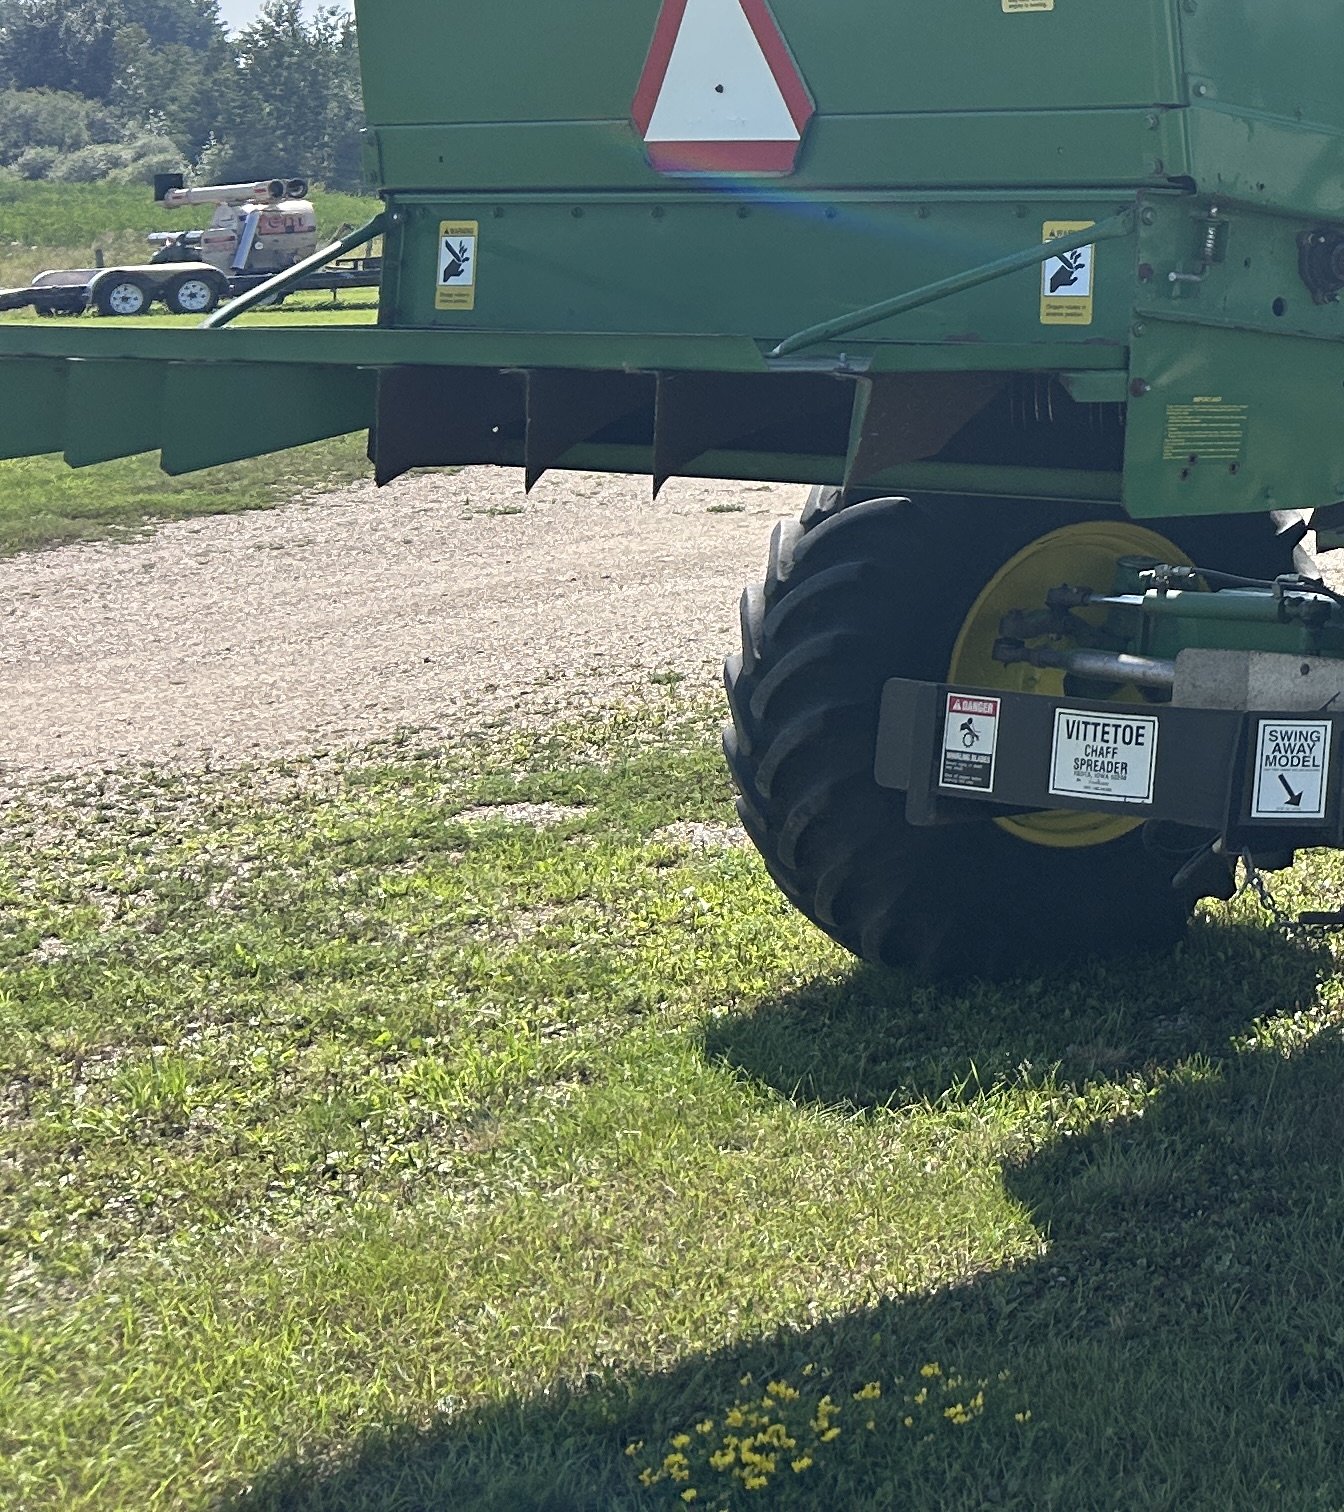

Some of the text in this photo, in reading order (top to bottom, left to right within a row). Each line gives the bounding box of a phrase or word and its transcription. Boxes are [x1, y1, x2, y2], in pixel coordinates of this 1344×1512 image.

[962, 700, 994, 714] DANGER
[1066, 719, 1146, 746] VITTETOE
[1268, 729, 1321, 743] SWING
[1084, 744, 1118, 759] CHAFF
[1272, 742, 1316, 755] AWAY
[1073, 758, 1128, 775] SPREADER
[1265, 755, 1320, 767] MODEL
